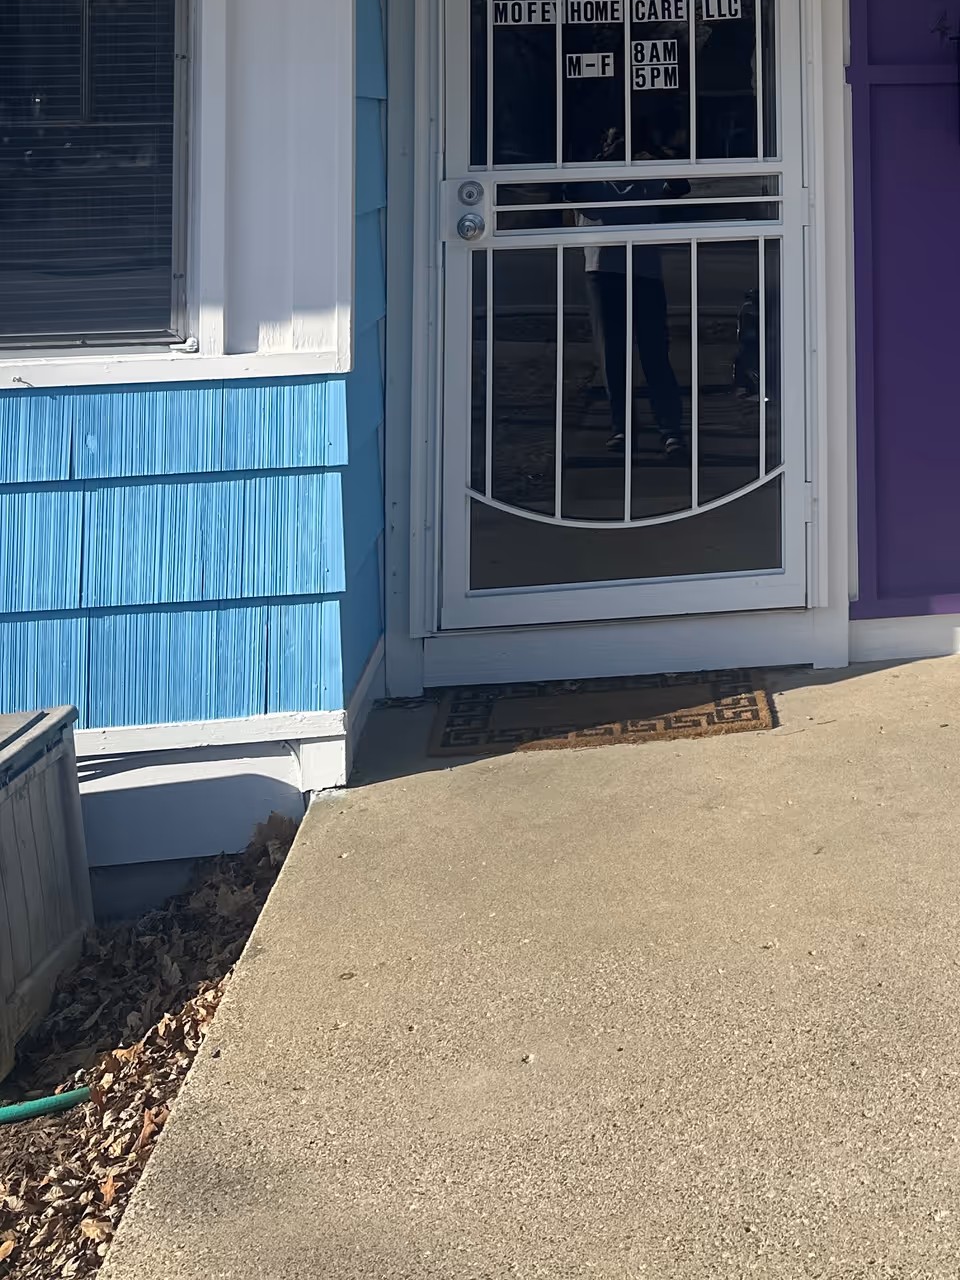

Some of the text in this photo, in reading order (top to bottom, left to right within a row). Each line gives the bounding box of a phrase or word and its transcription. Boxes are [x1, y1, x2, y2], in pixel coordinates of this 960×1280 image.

[570, 0, 620, 22] HOME
[635, 0, 684, 22] CARE
[633, 42, 677, 63] 8AM
[568, 55, 611, 77] M-F
[634, 66, 678, 88] 5PM
